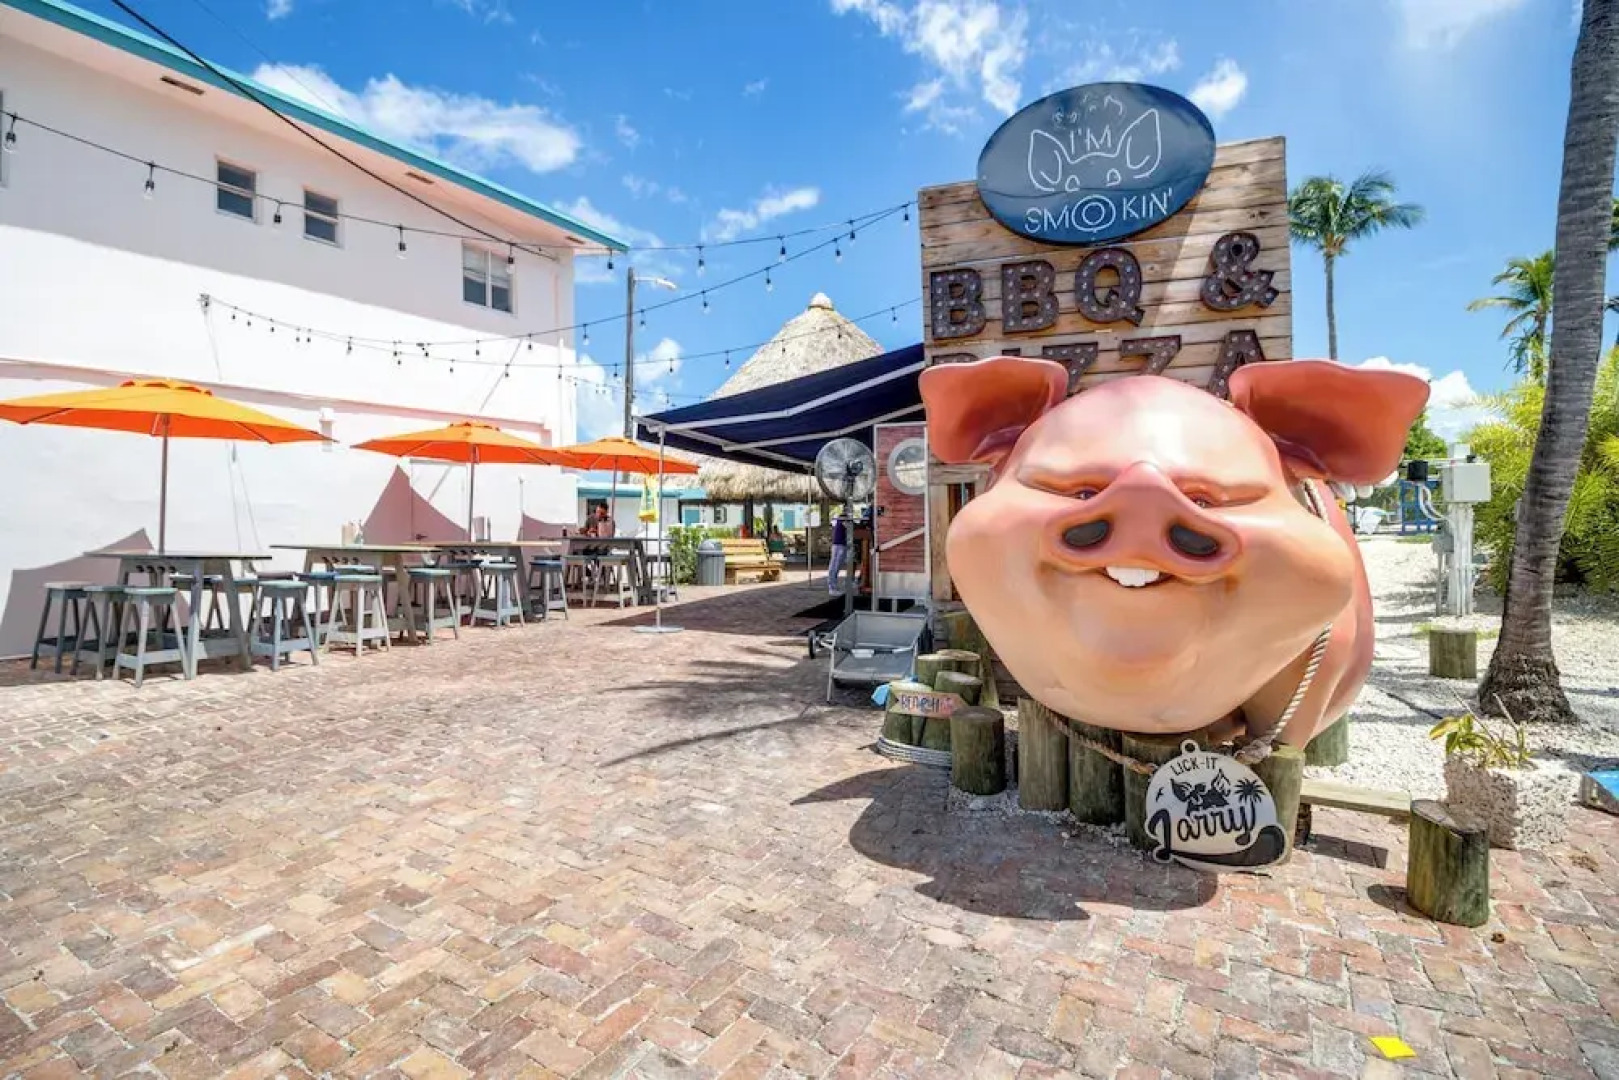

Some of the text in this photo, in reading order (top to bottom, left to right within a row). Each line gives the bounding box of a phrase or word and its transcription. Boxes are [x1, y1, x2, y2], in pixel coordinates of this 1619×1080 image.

[1069, 124, 1112, 155] I'M
[1024, 187, 1173, 233] SMOKIN'
[930, 232, 1280, 340] BBQ &
[931, 329, 1266, 399] ZZA
[1170, 757, 1218, 776] LICK-IT
